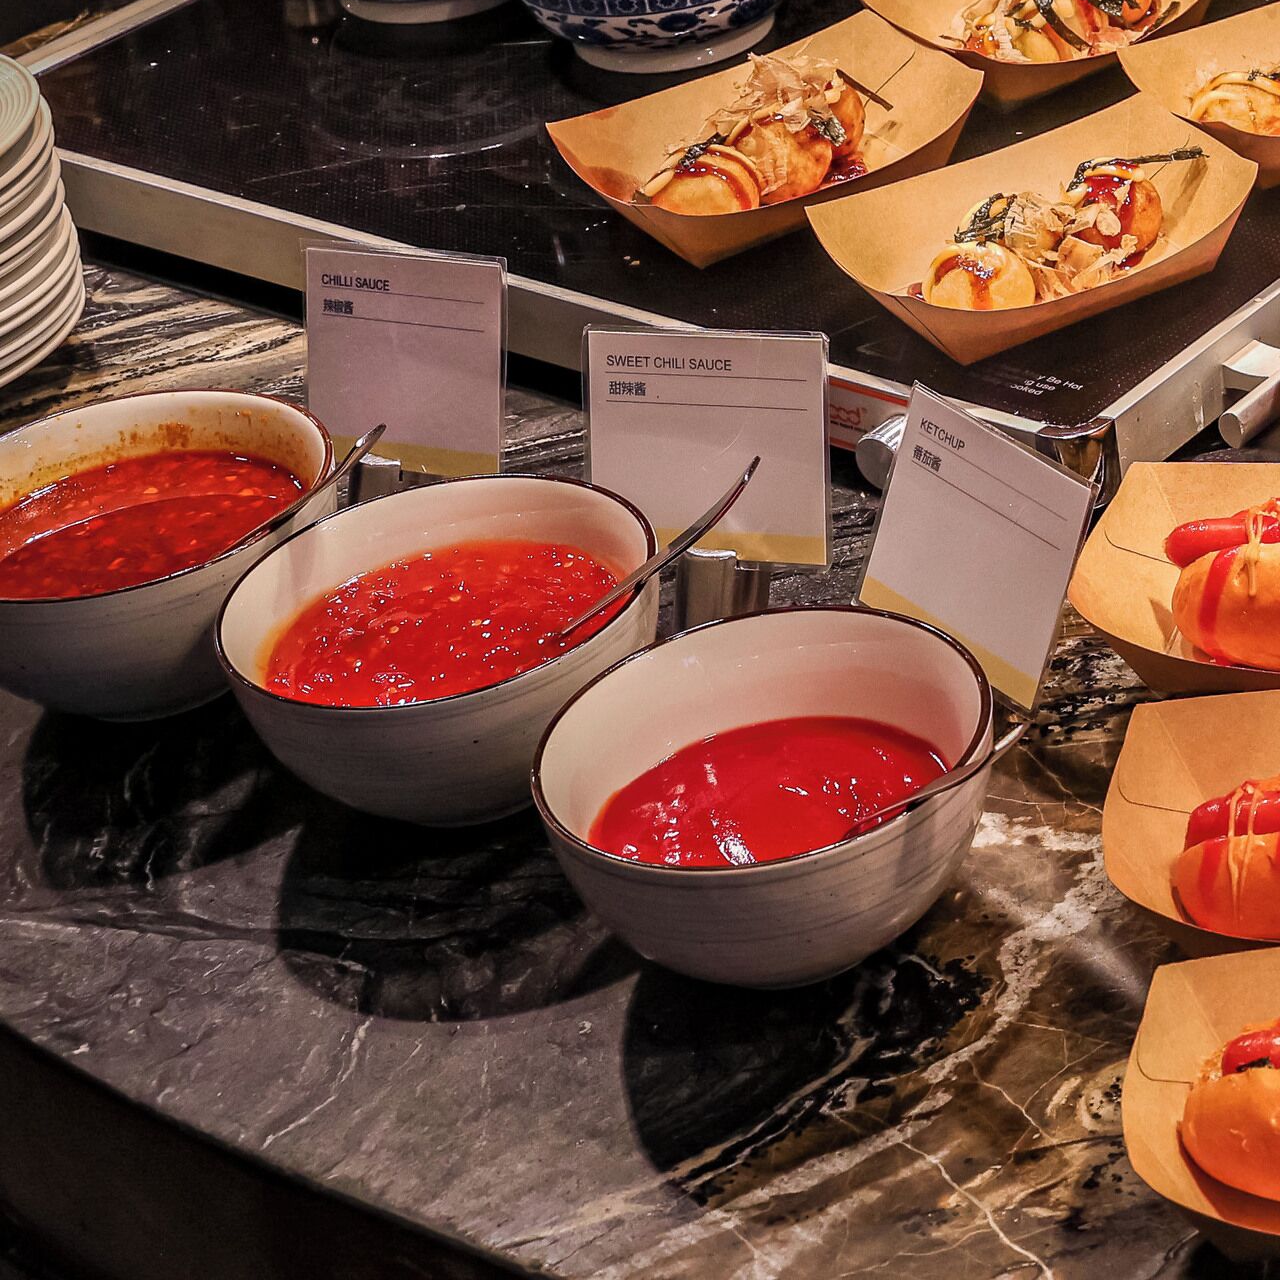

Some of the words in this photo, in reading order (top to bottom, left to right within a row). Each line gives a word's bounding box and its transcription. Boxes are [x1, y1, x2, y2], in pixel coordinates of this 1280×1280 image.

[321, 273, 353, 288] CHILLI
[355, 277, 390, 291] SAUCE
[323, 298, 354, 315] 辣椒酱
[606, 354, 651, 368] SWEET
[653, 356, 685, 369] CHILI
[688, 358, 732, 371] SAUCE
[609, 380, 646, 396] 甜辣酱
[920, 417, 966, 451] KETCHUP
[912, 444, 943, 472] 番茄酱
